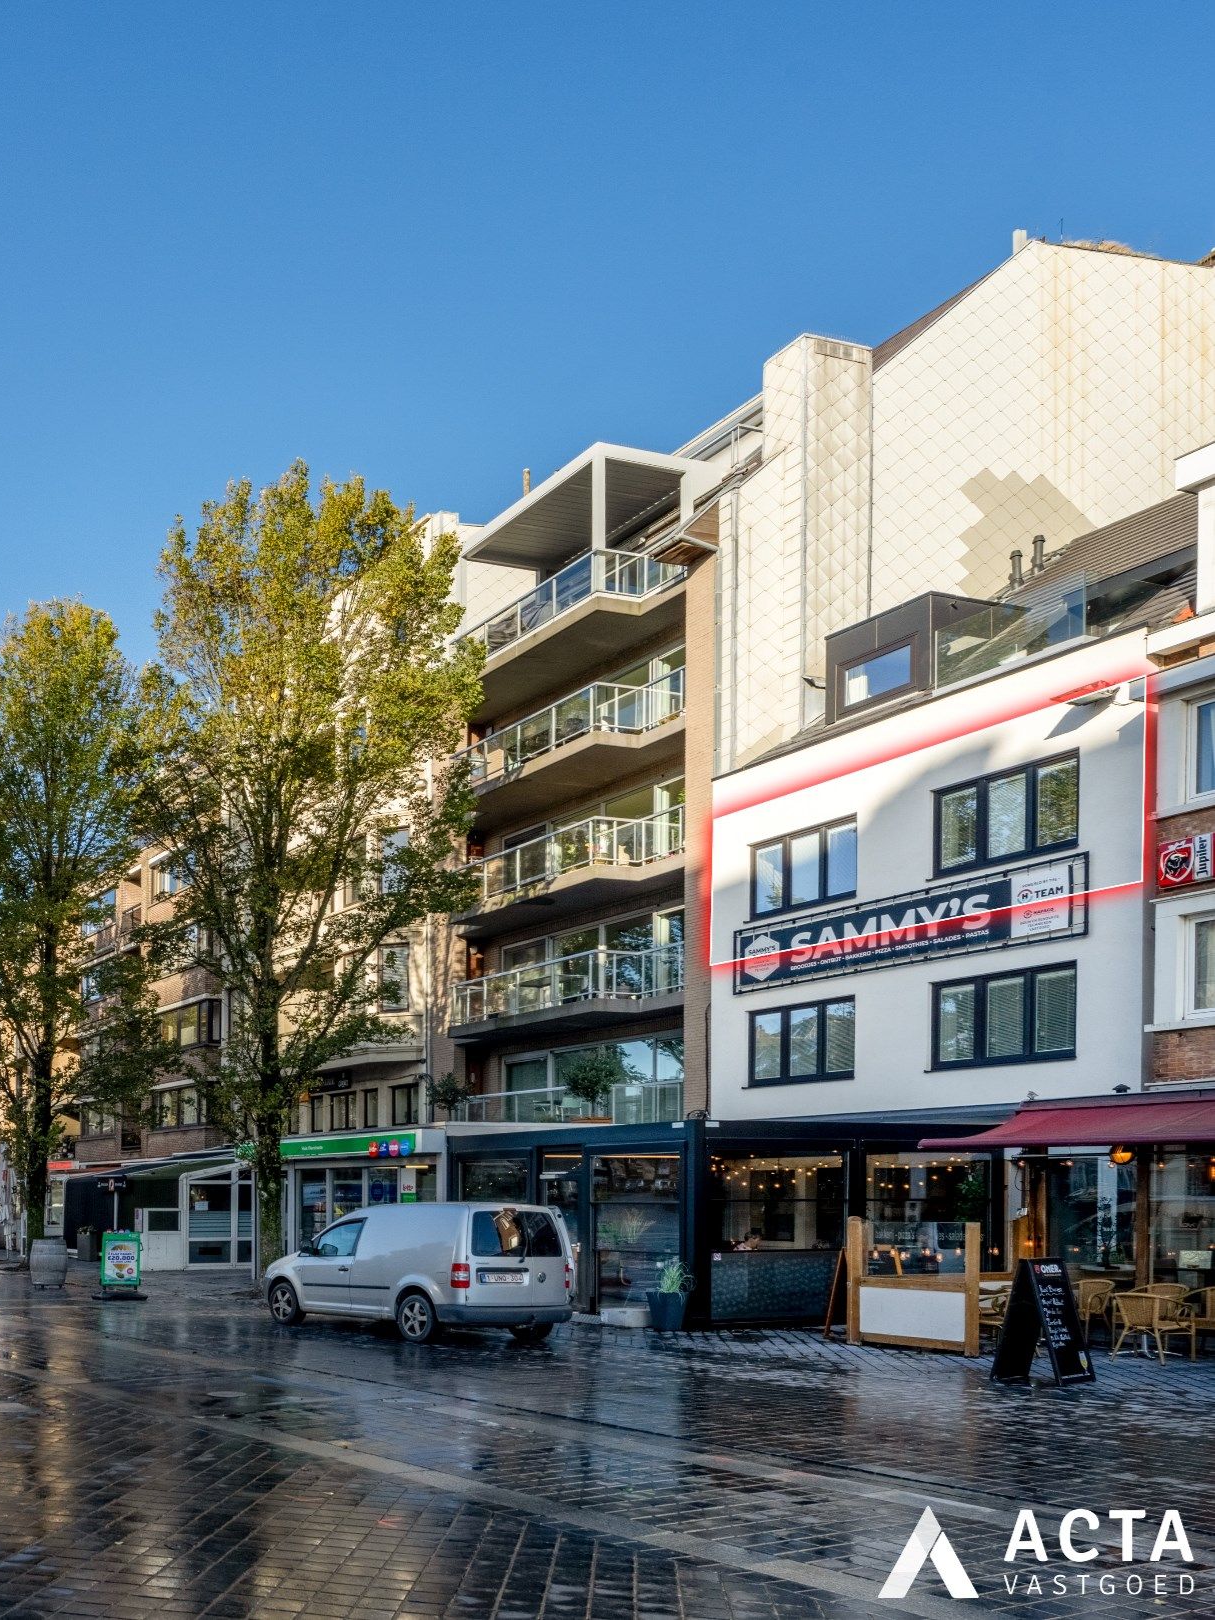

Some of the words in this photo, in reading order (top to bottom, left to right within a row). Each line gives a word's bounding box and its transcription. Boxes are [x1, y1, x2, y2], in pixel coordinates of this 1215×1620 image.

[1196, 836, 1210, 877] Jupiler
[1035, 886, 1064, 898] TEAM
[790, 894, 991, 963] SAMMY'S
[874, 947, 892, 955] PIZZA
[966, 929, 990, 938] PASTAS
